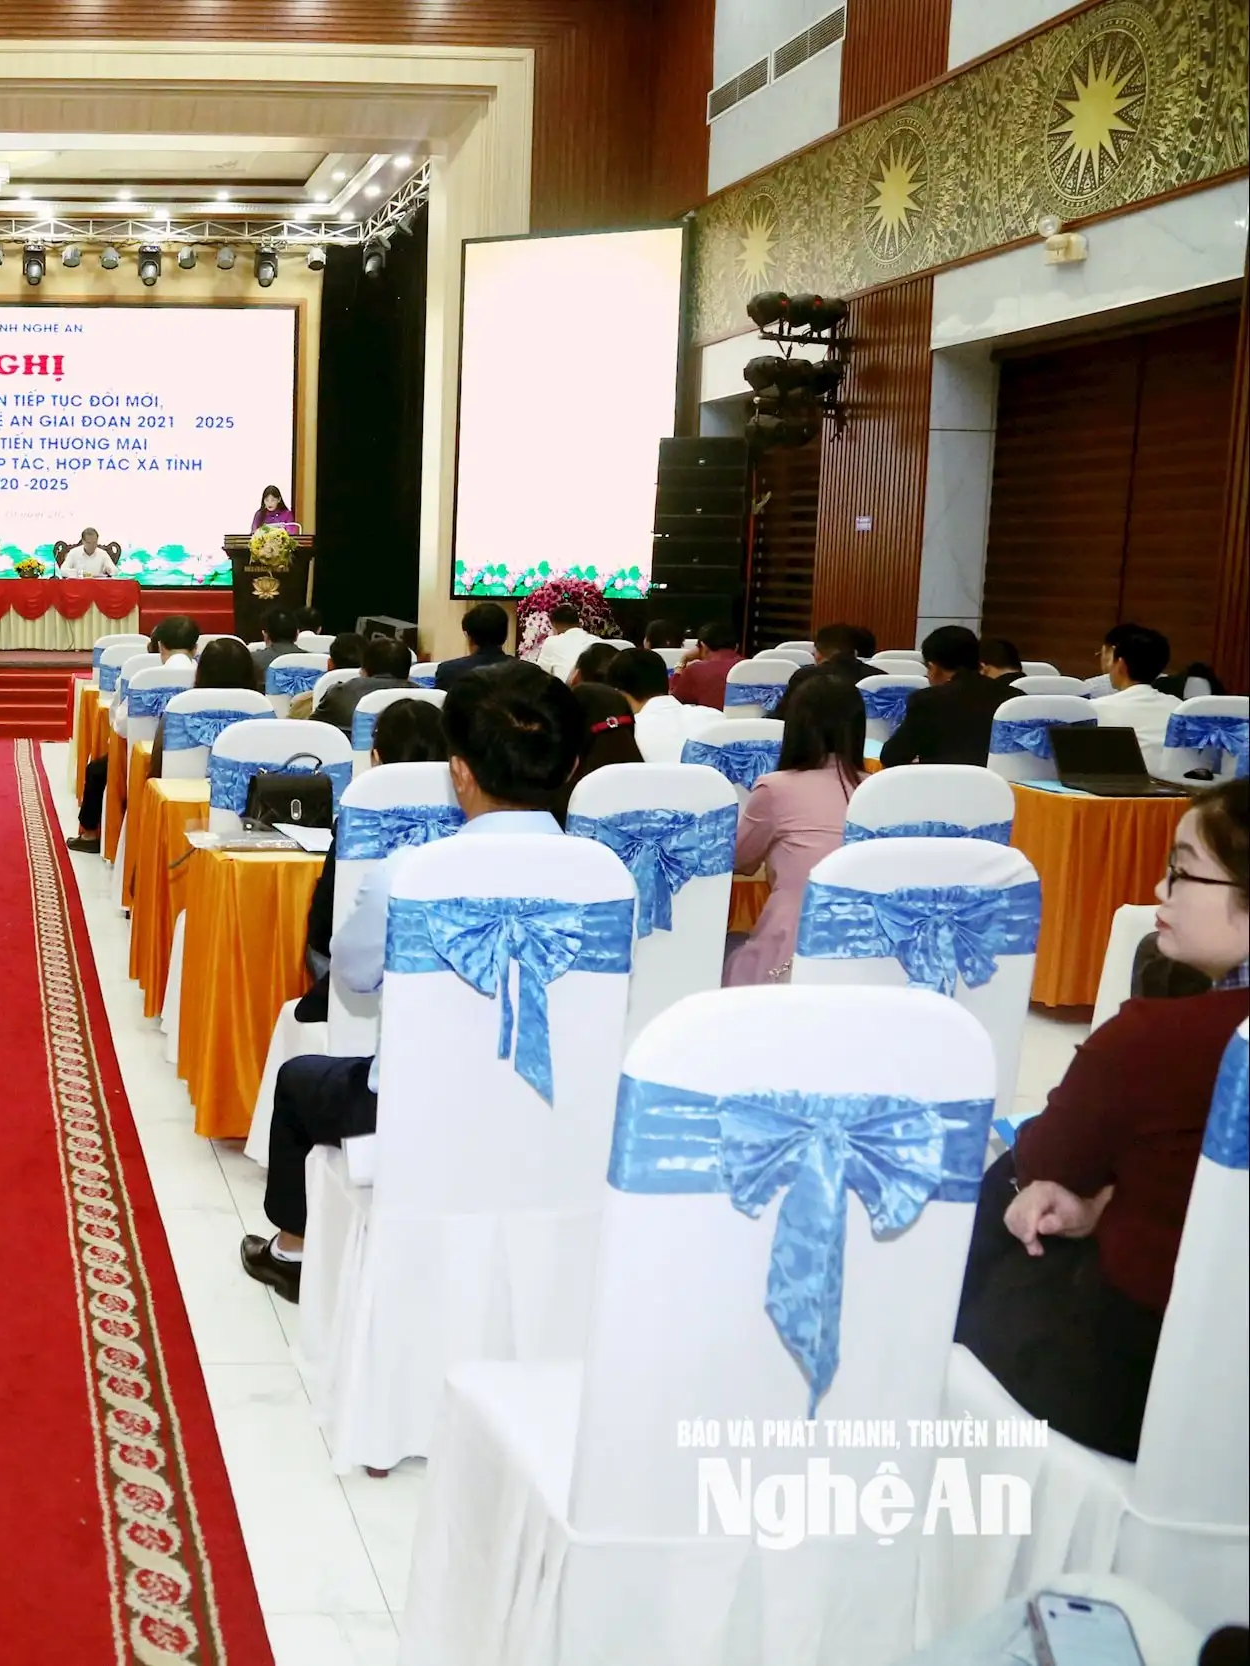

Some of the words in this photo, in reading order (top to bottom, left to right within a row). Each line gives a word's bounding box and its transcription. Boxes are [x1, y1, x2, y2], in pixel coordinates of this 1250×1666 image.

[64, 323, 84, 333] AN
[14, 388, 45, 406] TIẾP
[10, 415, 32, 427] AN
[39, 415, 75, 427] GIAI
[138, 416, 174, 428] 2021
[195, 416, 234, 428] 2025
[24, 478, 68, 490] -2025
